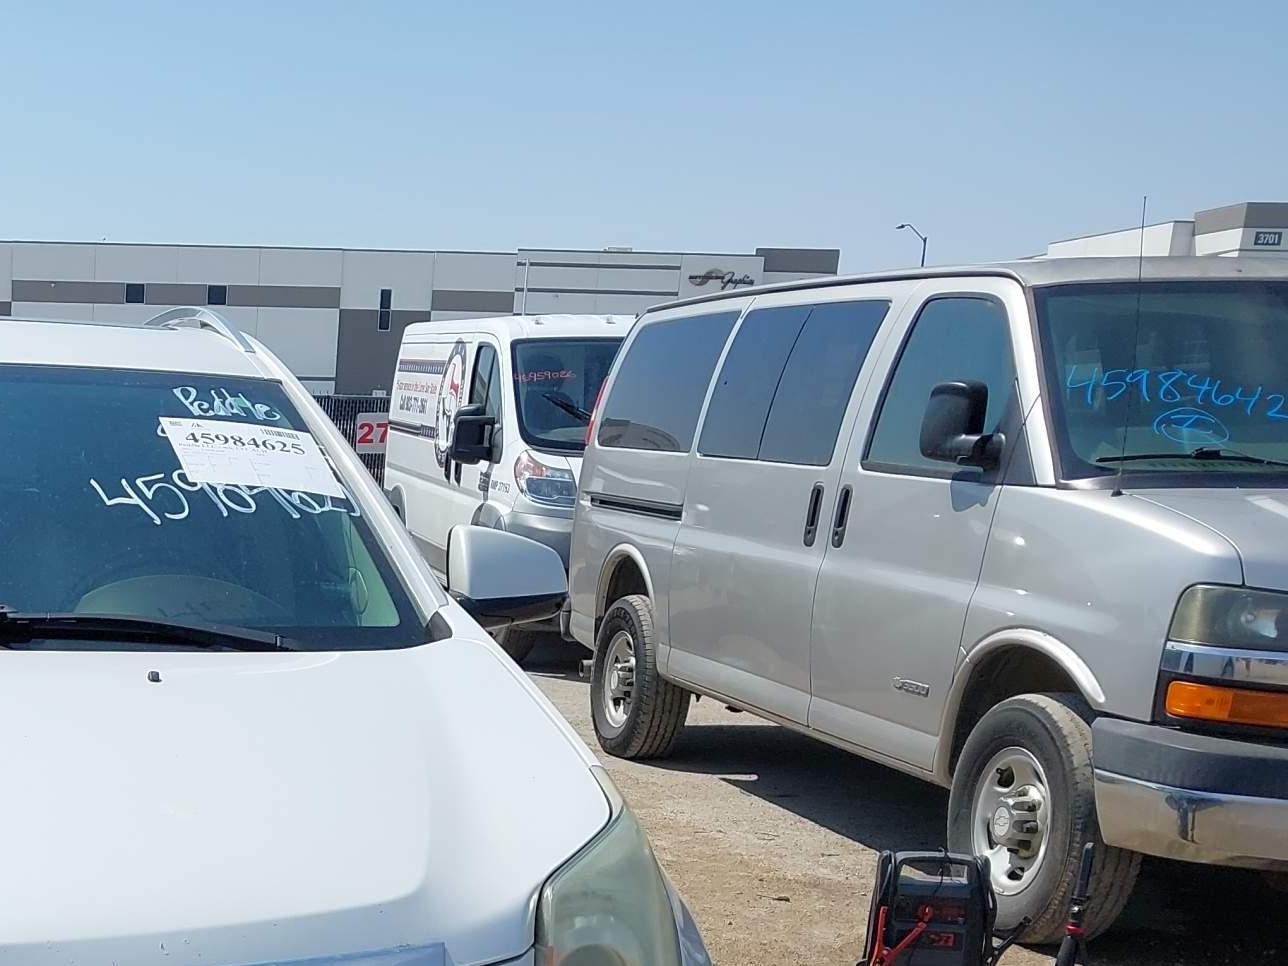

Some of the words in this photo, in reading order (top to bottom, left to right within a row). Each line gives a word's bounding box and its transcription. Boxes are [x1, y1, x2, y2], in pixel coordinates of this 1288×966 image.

[1257, 233, 1279, 244] 3701
[1065, 366, 1288, 422] 45984642
[185, 431, 306, 456] 45984625
[357, 422, 390, 444] 27
